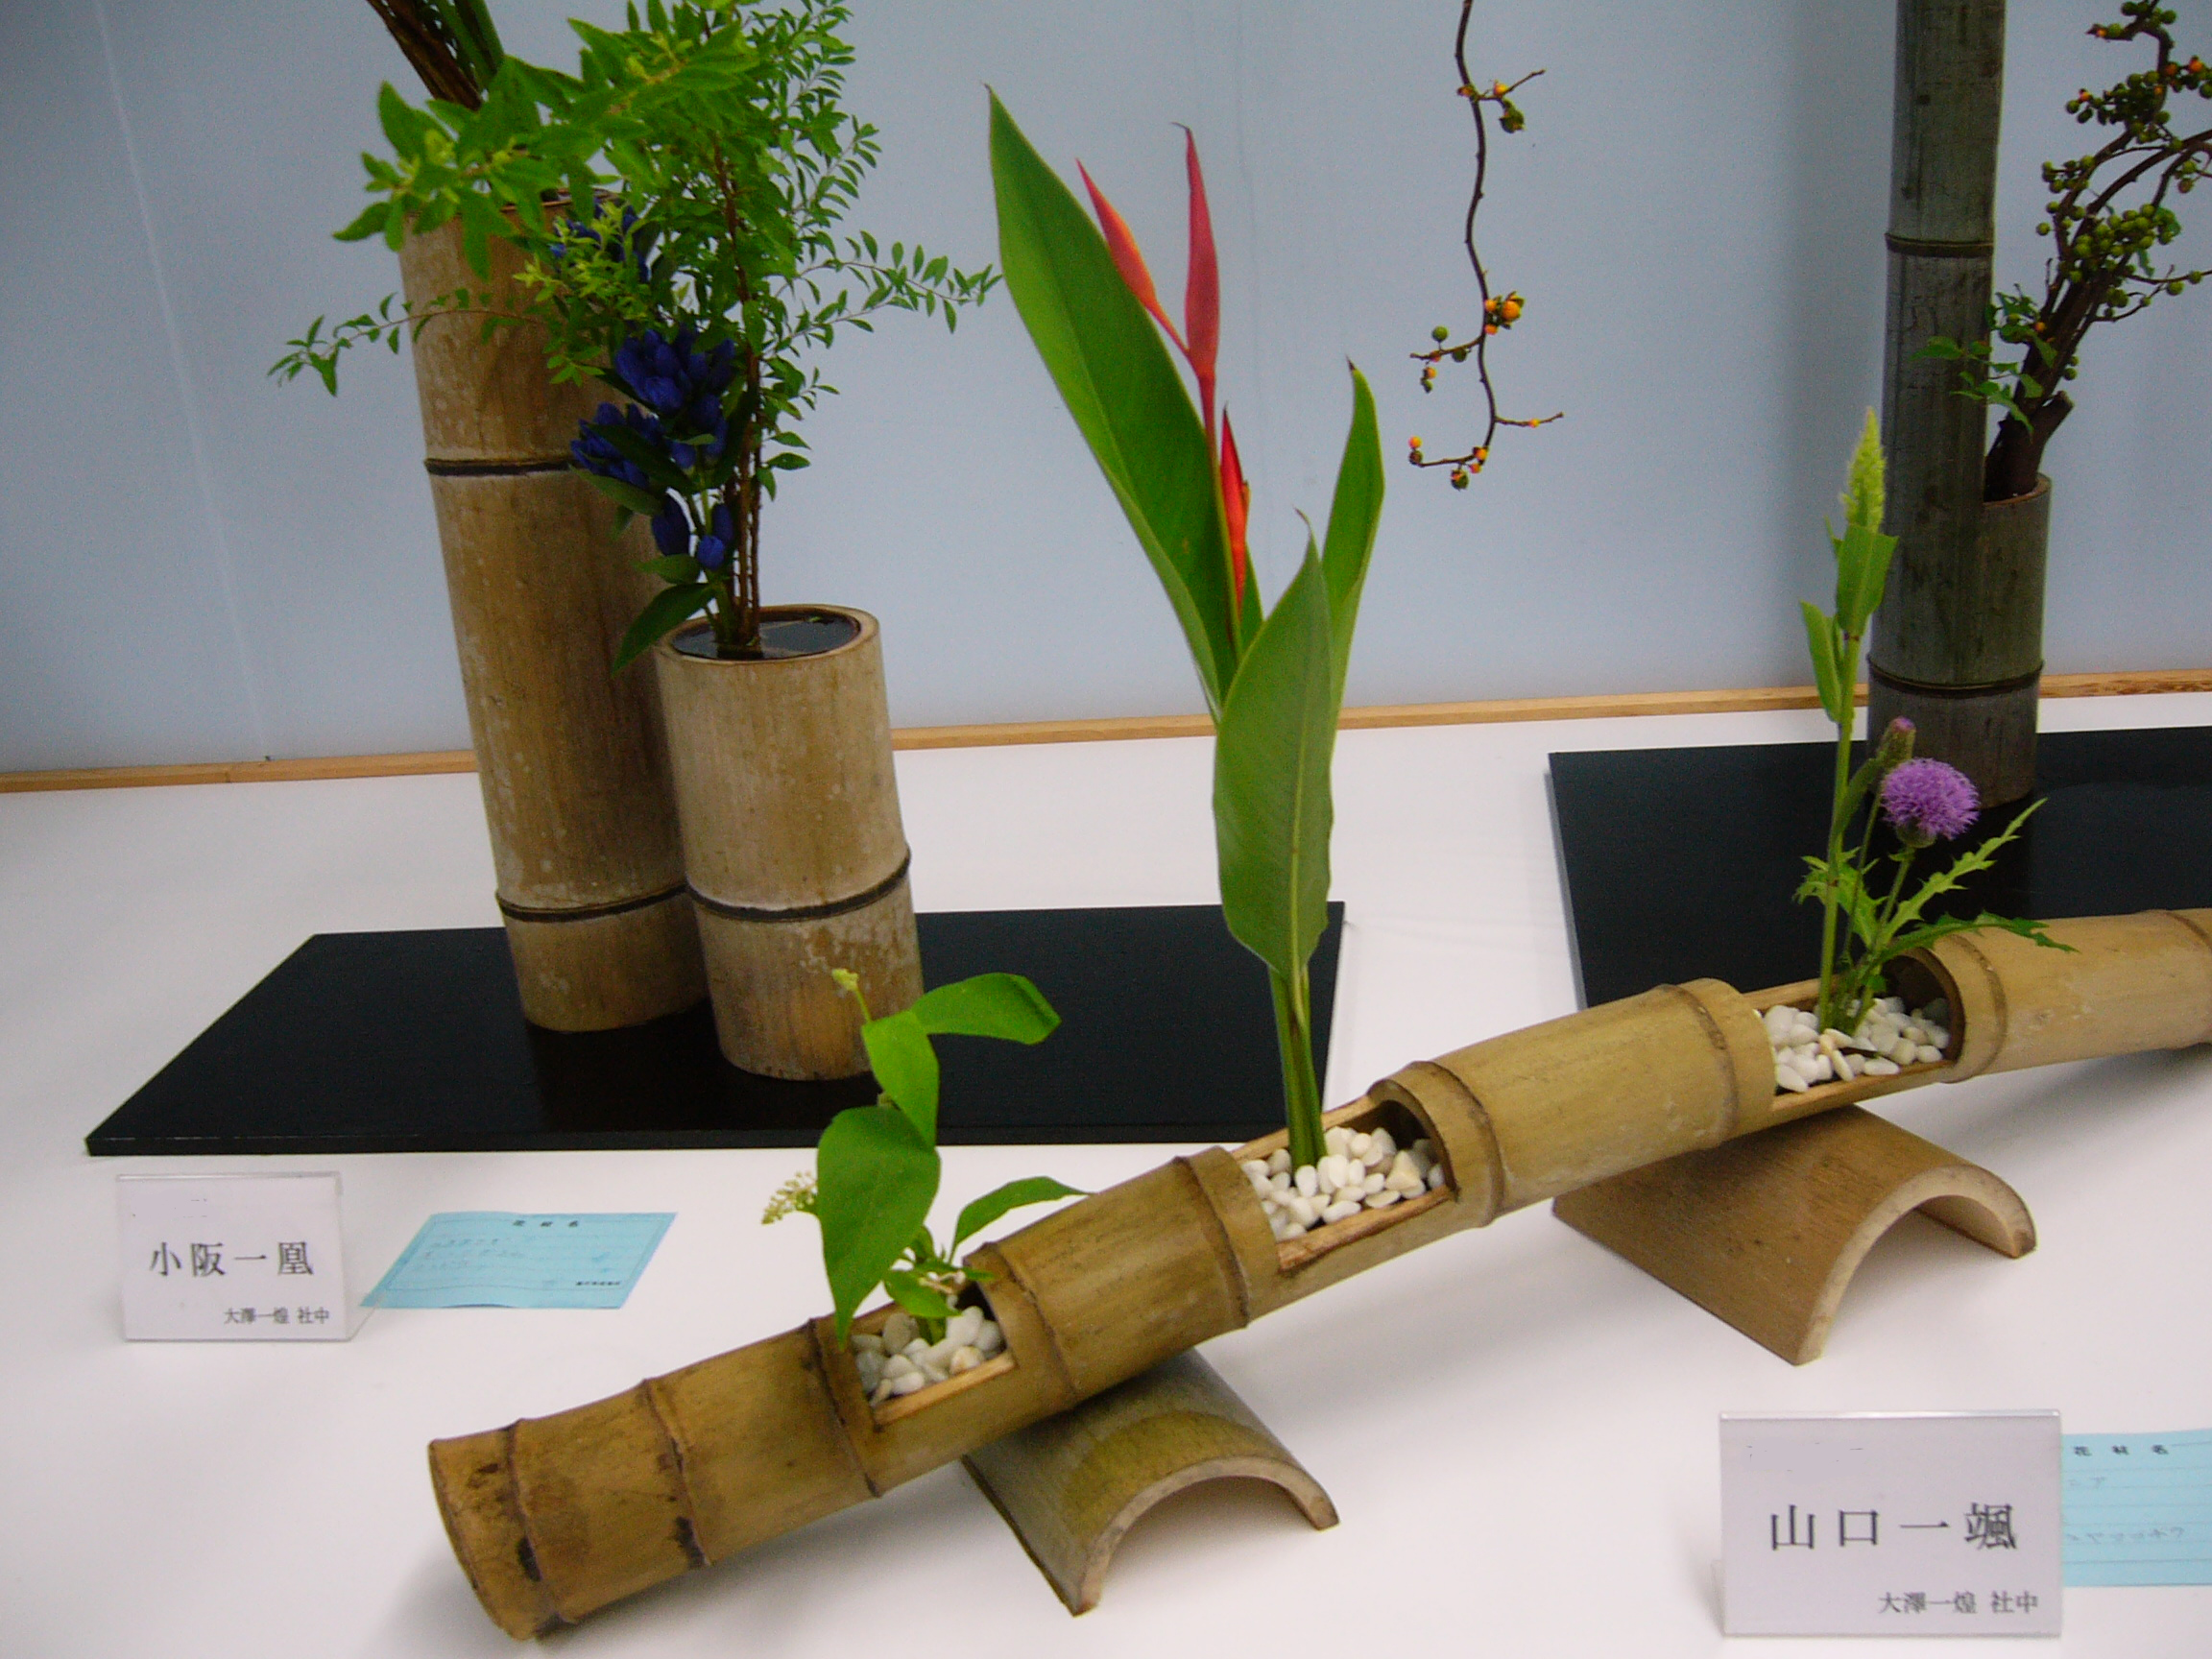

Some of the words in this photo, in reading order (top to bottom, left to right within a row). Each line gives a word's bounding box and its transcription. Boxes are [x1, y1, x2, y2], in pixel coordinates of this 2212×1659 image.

[150, 1241, 314, 1277] 小阪一凰
[297, 1307, 330, 1324] 社中
[1770, 1503, 2017, 1551] 山口一颯
[1990, 1590, 2039, 1614] 社中
